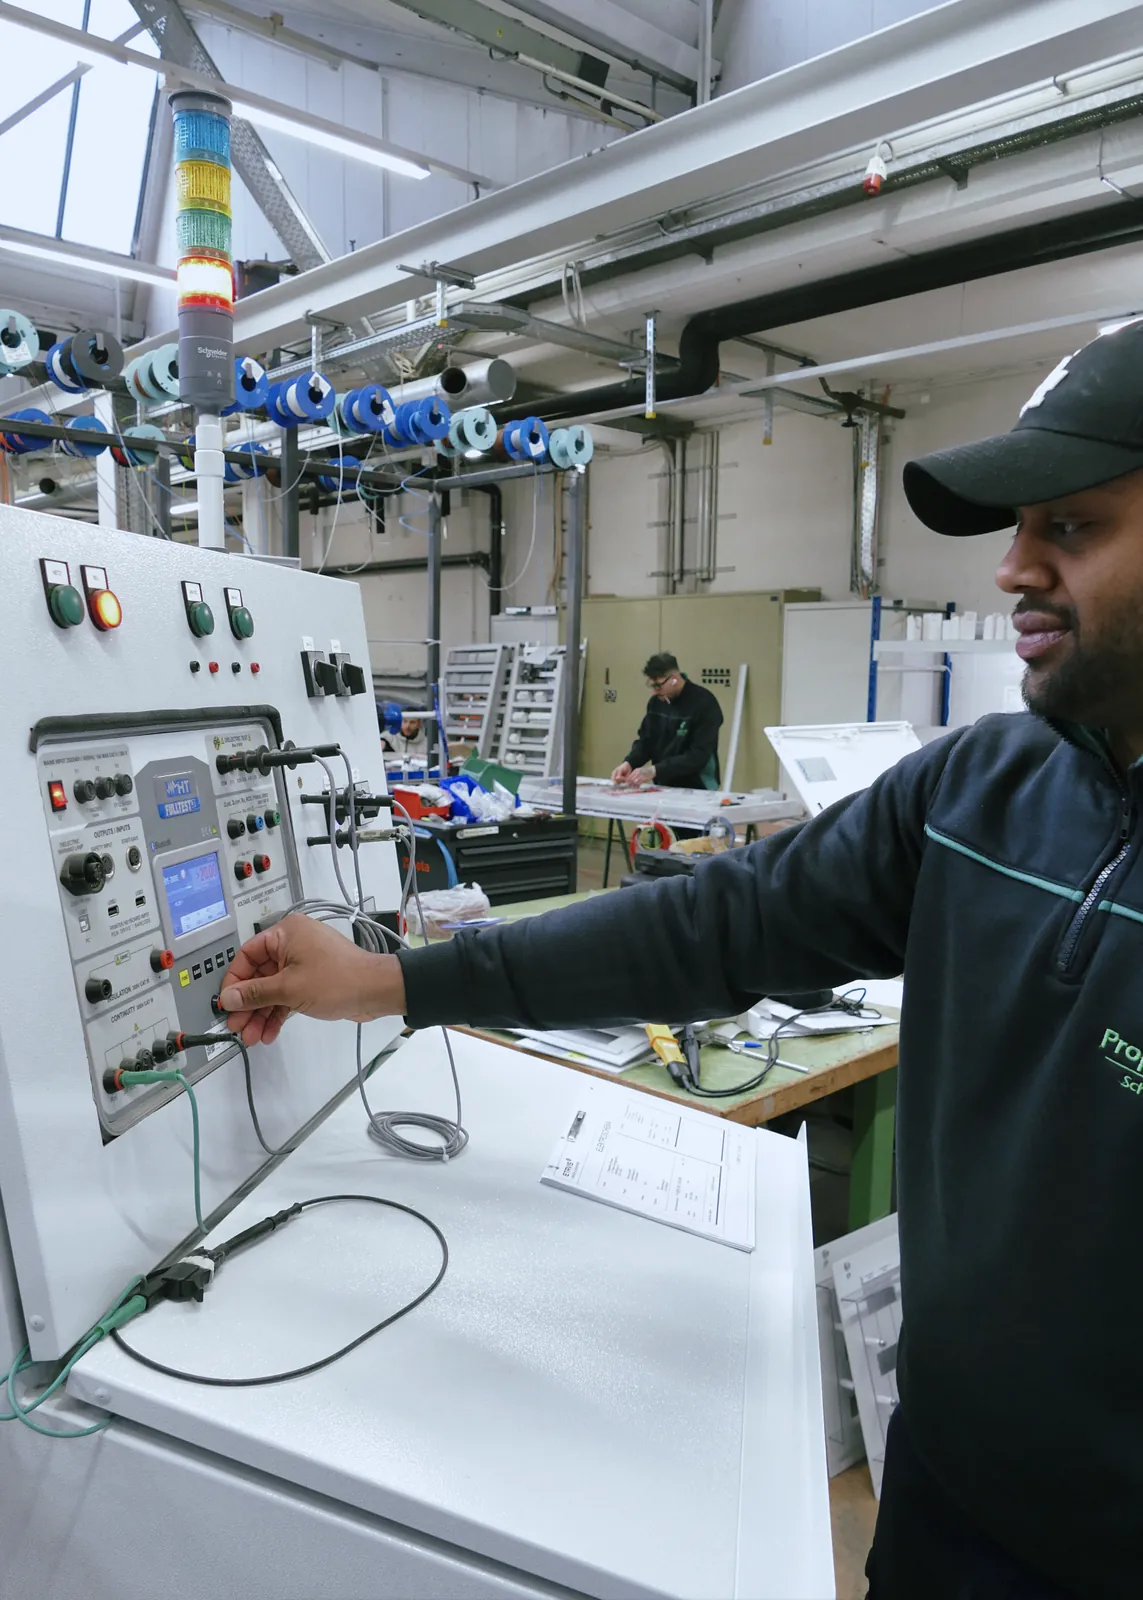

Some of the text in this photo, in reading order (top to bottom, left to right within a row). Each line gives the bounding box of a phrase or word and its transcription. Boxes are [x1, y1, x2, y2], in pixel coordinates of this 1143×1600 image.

[198, 346, 228, 358] Schneider
[94, 828, 113, 838] OUTPUTS
[116, 824, 130, 832] INPUTS
[111, 1005, 135, 1023] CONTINUITY
